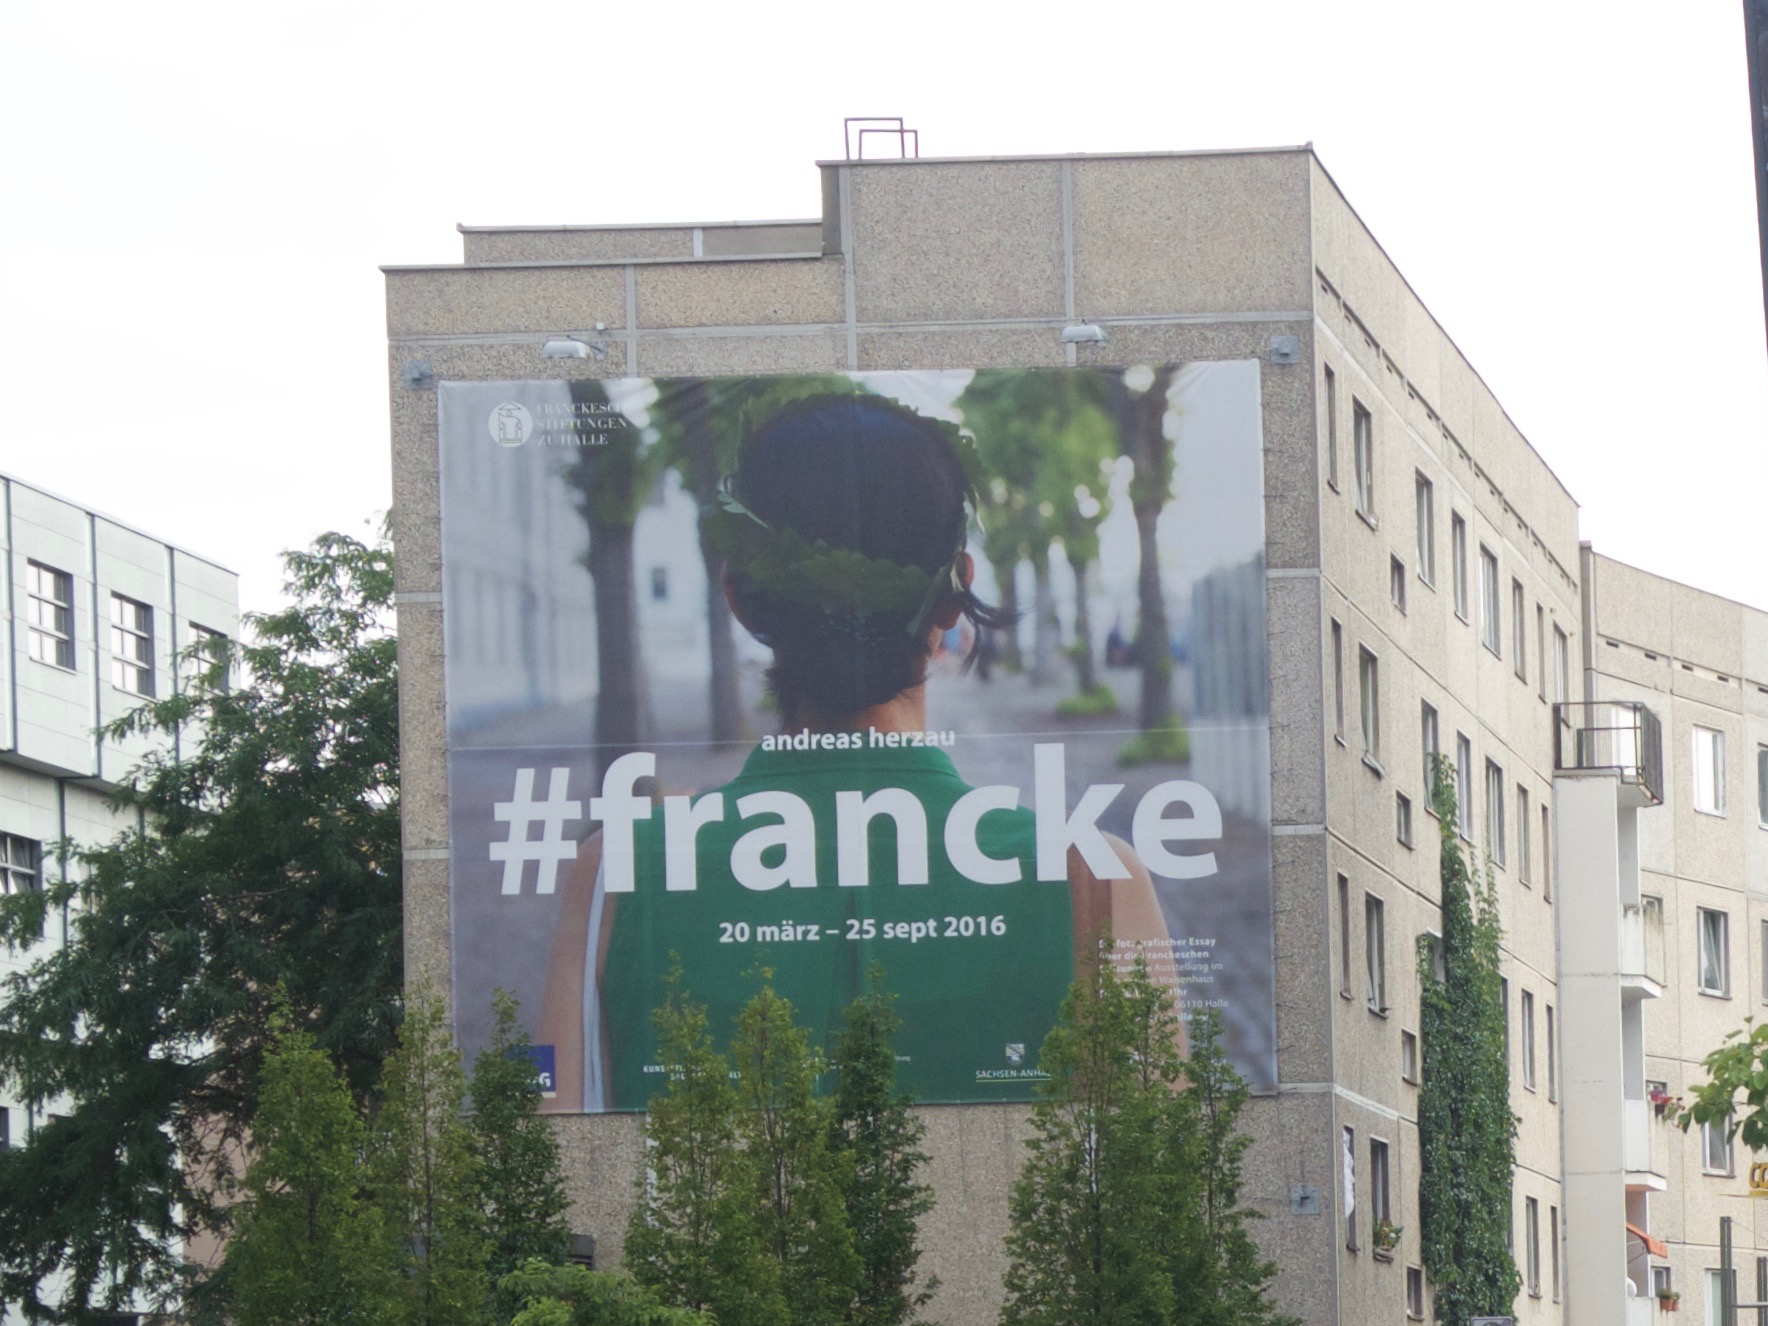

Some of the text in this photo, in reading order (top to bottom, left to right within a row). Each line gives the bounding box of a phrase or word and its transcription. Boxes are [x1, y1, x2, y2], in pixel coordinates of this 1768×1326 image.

[537, 402, 622, 415] FRANCKESC
[537, 417, 628, 431] STIFTUNGEN
[537, 432, 609, 446] ZU HALLE
[761, 726, 956, 751] andreas herzau
[489, 743, 1223, 895] #francke
[718, 922, 750, 944] 20
[756, 919, 820, 942] märz
[845, 918, 877, 940] 25
[882, 917, 938, 943] sept
[943, 914, 1007, 937] 2016
[1188, 937, 1217, 948] Essay
[1154, 962, 1209, 972] Ausstellung
[1210, 962, 1223, 971] im
[1158, 974, 1214, 984] Waisenhaus
[1204, 999, 1230, 1009] Halle
